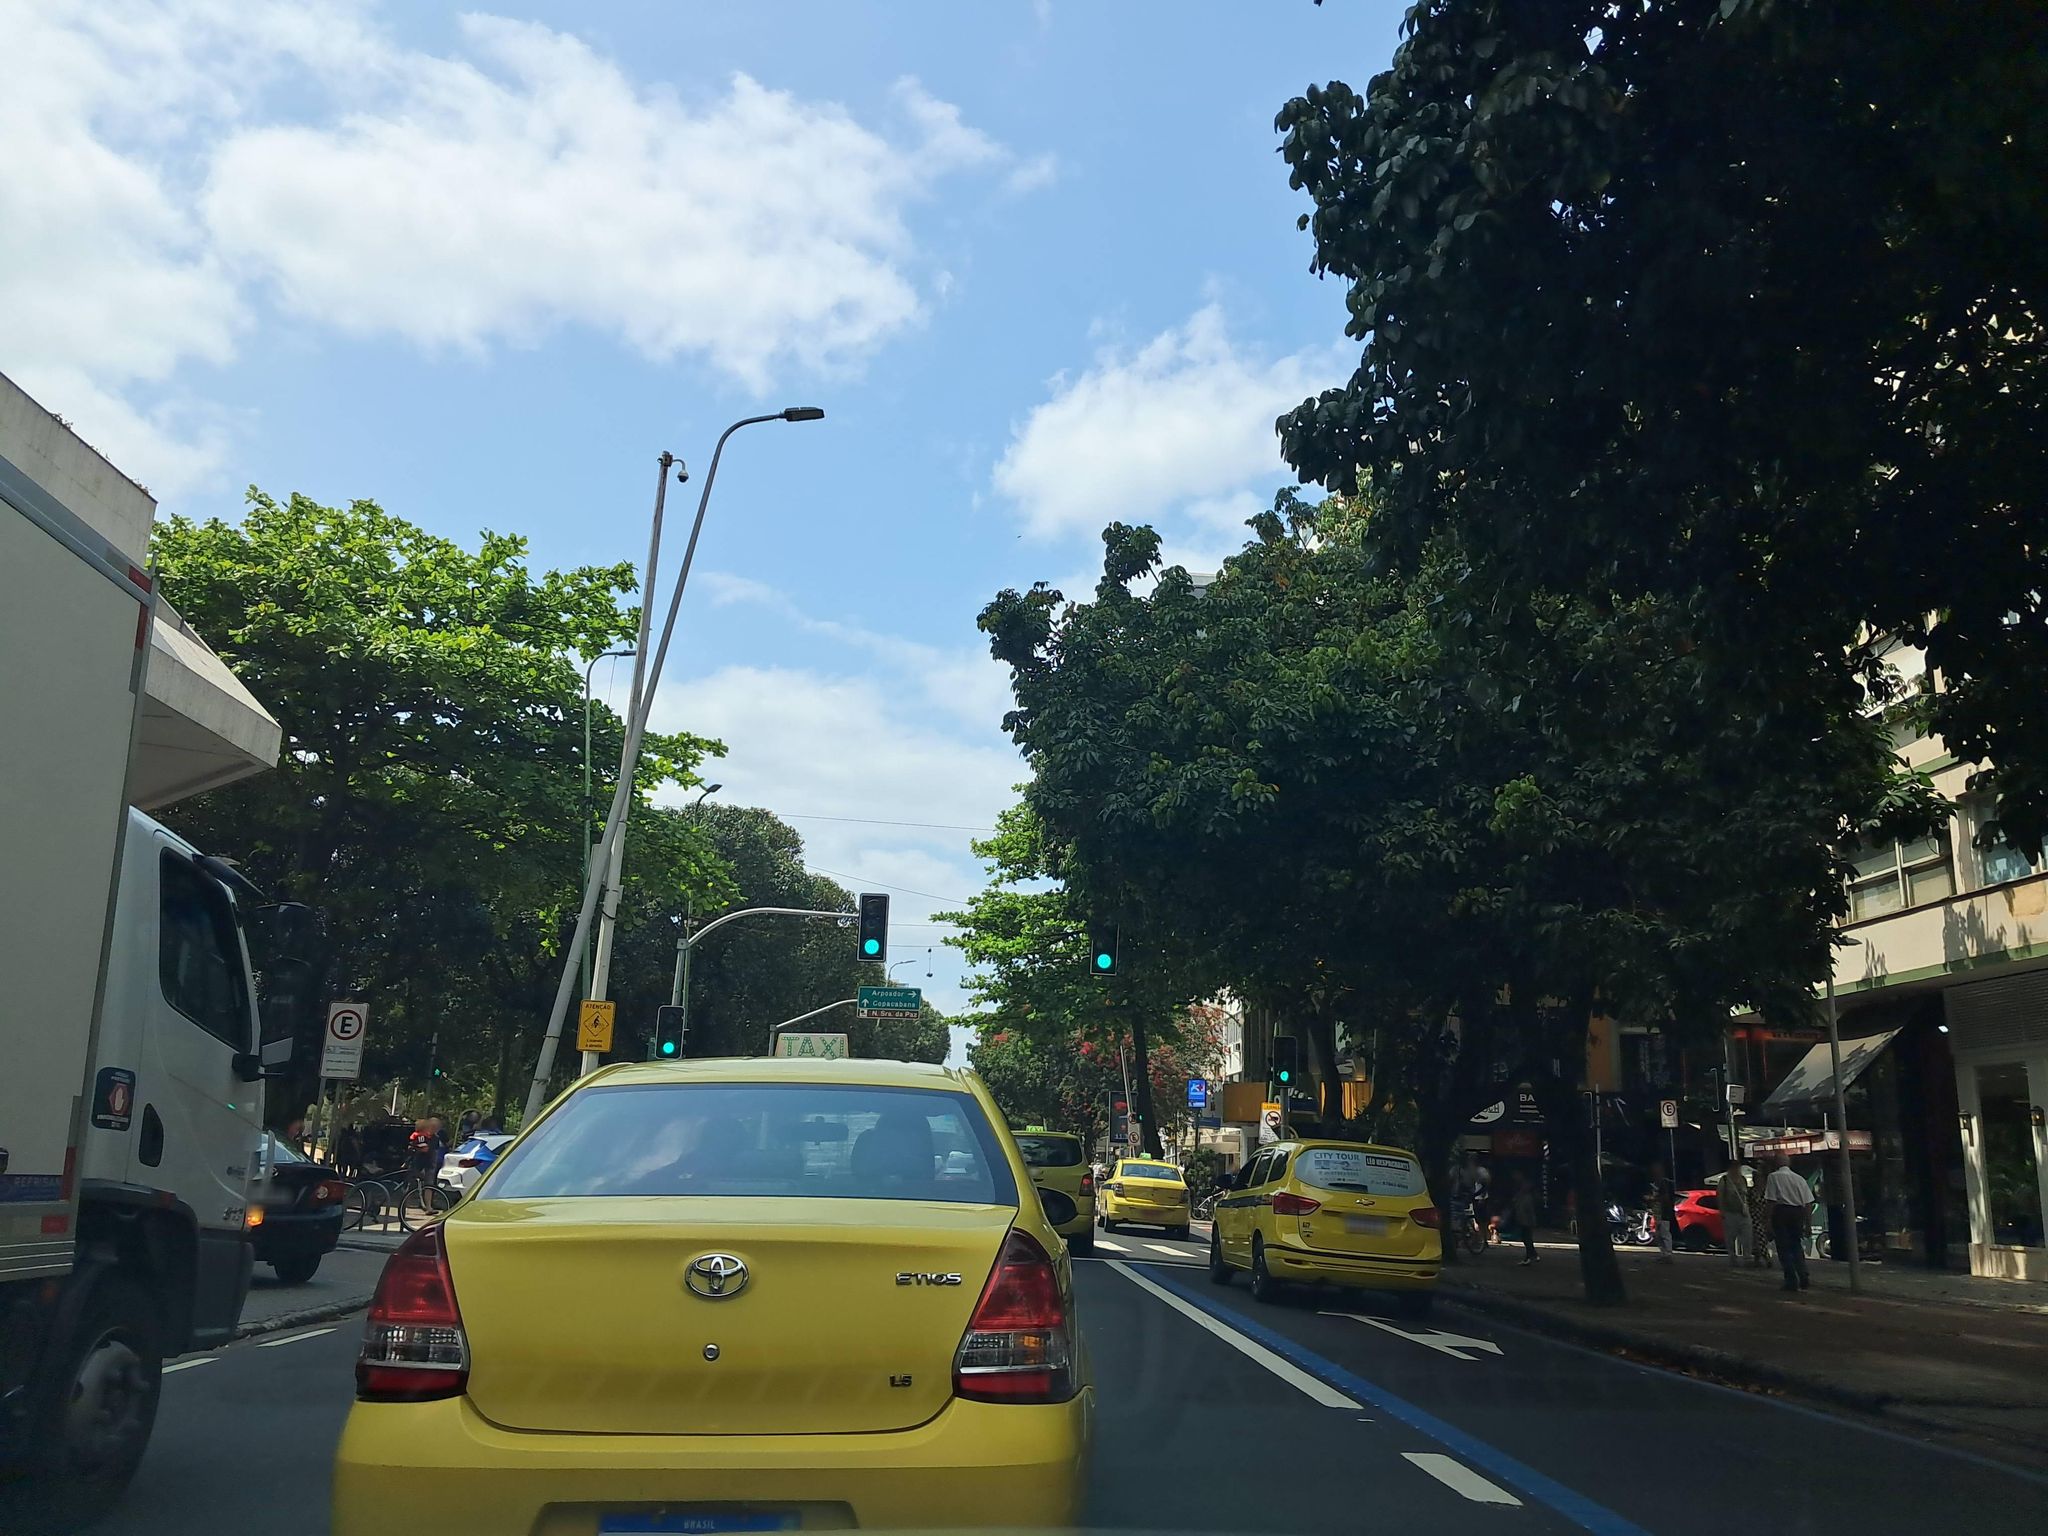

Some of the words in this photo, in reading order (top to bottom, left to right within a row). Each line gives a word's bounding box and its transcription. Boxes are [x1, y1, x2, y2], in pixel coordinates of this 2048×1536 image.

[872, 1000, 916, 1008] Copacabana
[340, 1015, 353, 1034] E
[781, 1036, 845, 1059] TAXI
[1666, 1105, 1673, 1114] E
[417, 1135, 425, 1143] 10
[1314, 1152, 1333, 1160] CITY
[1336, 1153, 1360, 1161] TOUR
[896, 1272, 962, 1286] ETIOS
[683, 1519, 716, 1530] BRASIL
